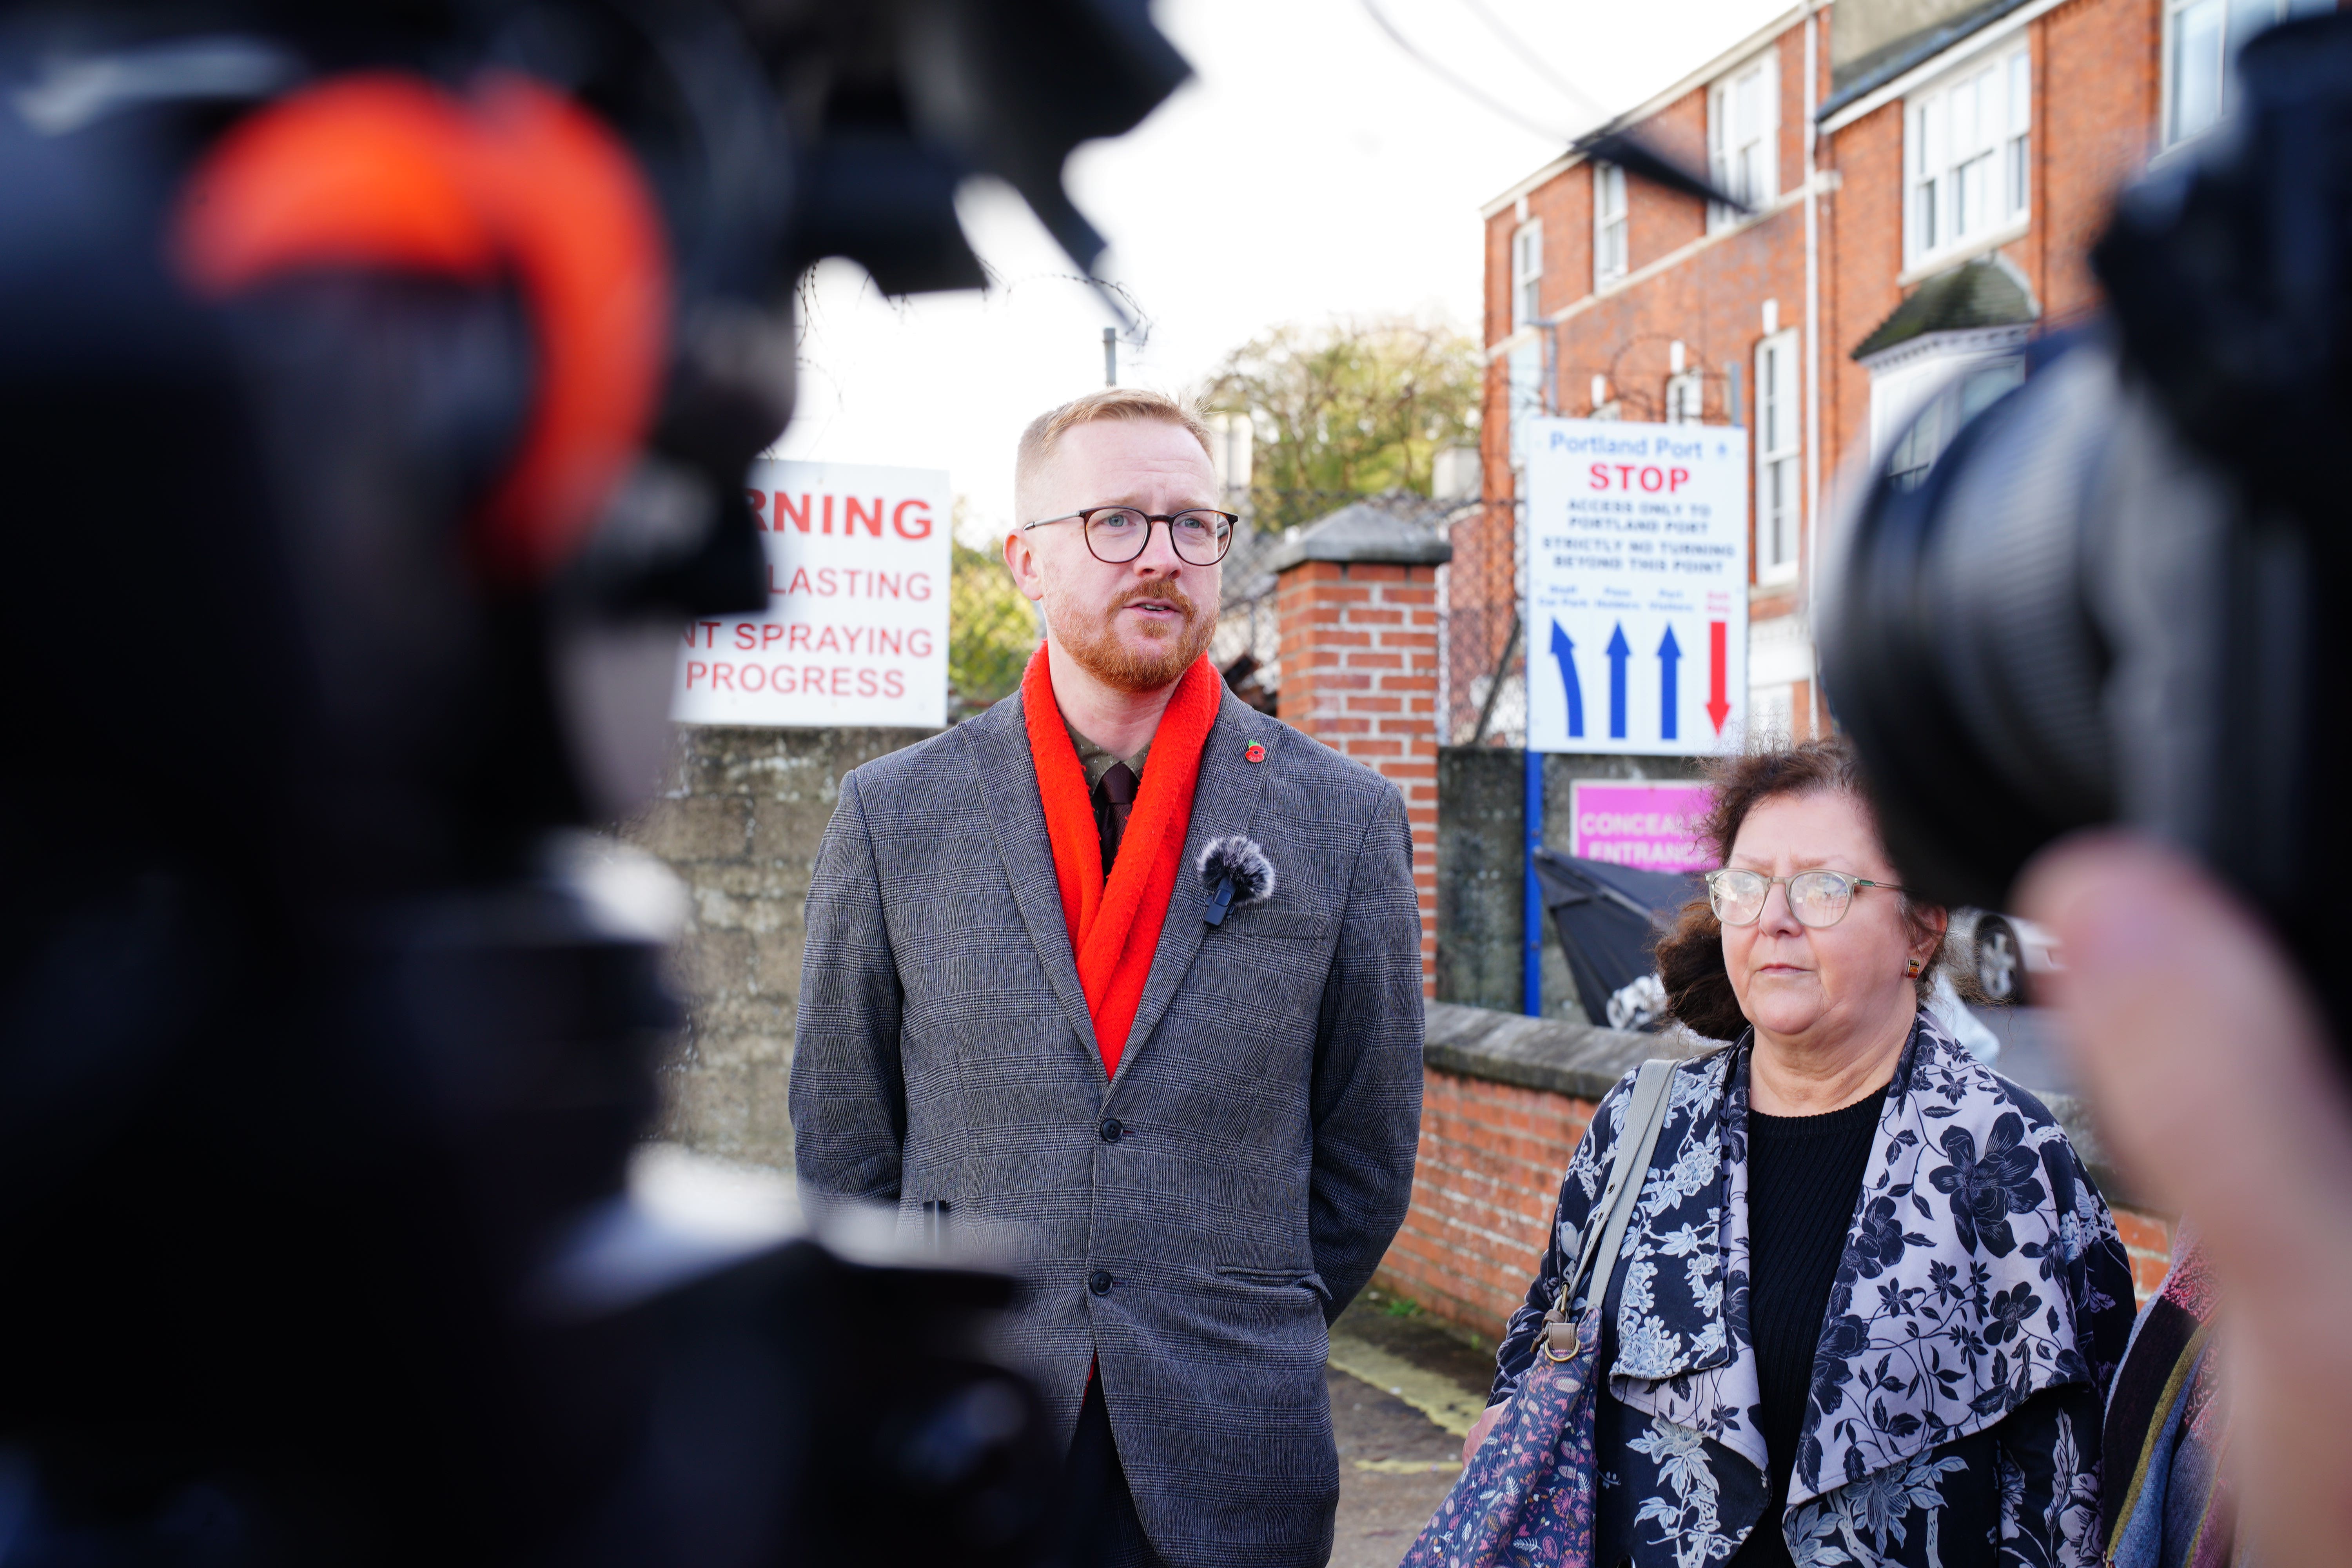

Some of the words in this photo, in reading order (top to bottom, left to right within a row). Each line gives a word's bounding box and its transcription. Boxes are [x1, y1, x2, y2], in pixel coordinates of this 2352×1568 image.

[1550, 431, 1648, 456] Portland
[1656, 437, 1703, 459] Port
[1589, 463, 1690, 494] STOP
[1568, 499, 1633, 514] ACCESS
[1640, 503, 1683, 515] ONLY
[1691, 505, 1711, 517] TO
[1570, 517, 1659, 532] PORTLAND
[1665, 521, 1709, 534] PORT
[1543, 537, 1623, 552] STRICTLY
[1629, 541, 1652, 554] NO
[1659, 543, 1736, 557] TURNING
[1554, 555, 1622, 570] BEYOND
[1629, 558, 1667, 571] THIS
[1673, 560, 1724, 573] POINT
[734, 623, 933, 658] SPRAYING
[686, 661, 906, 698] PROGRESS
